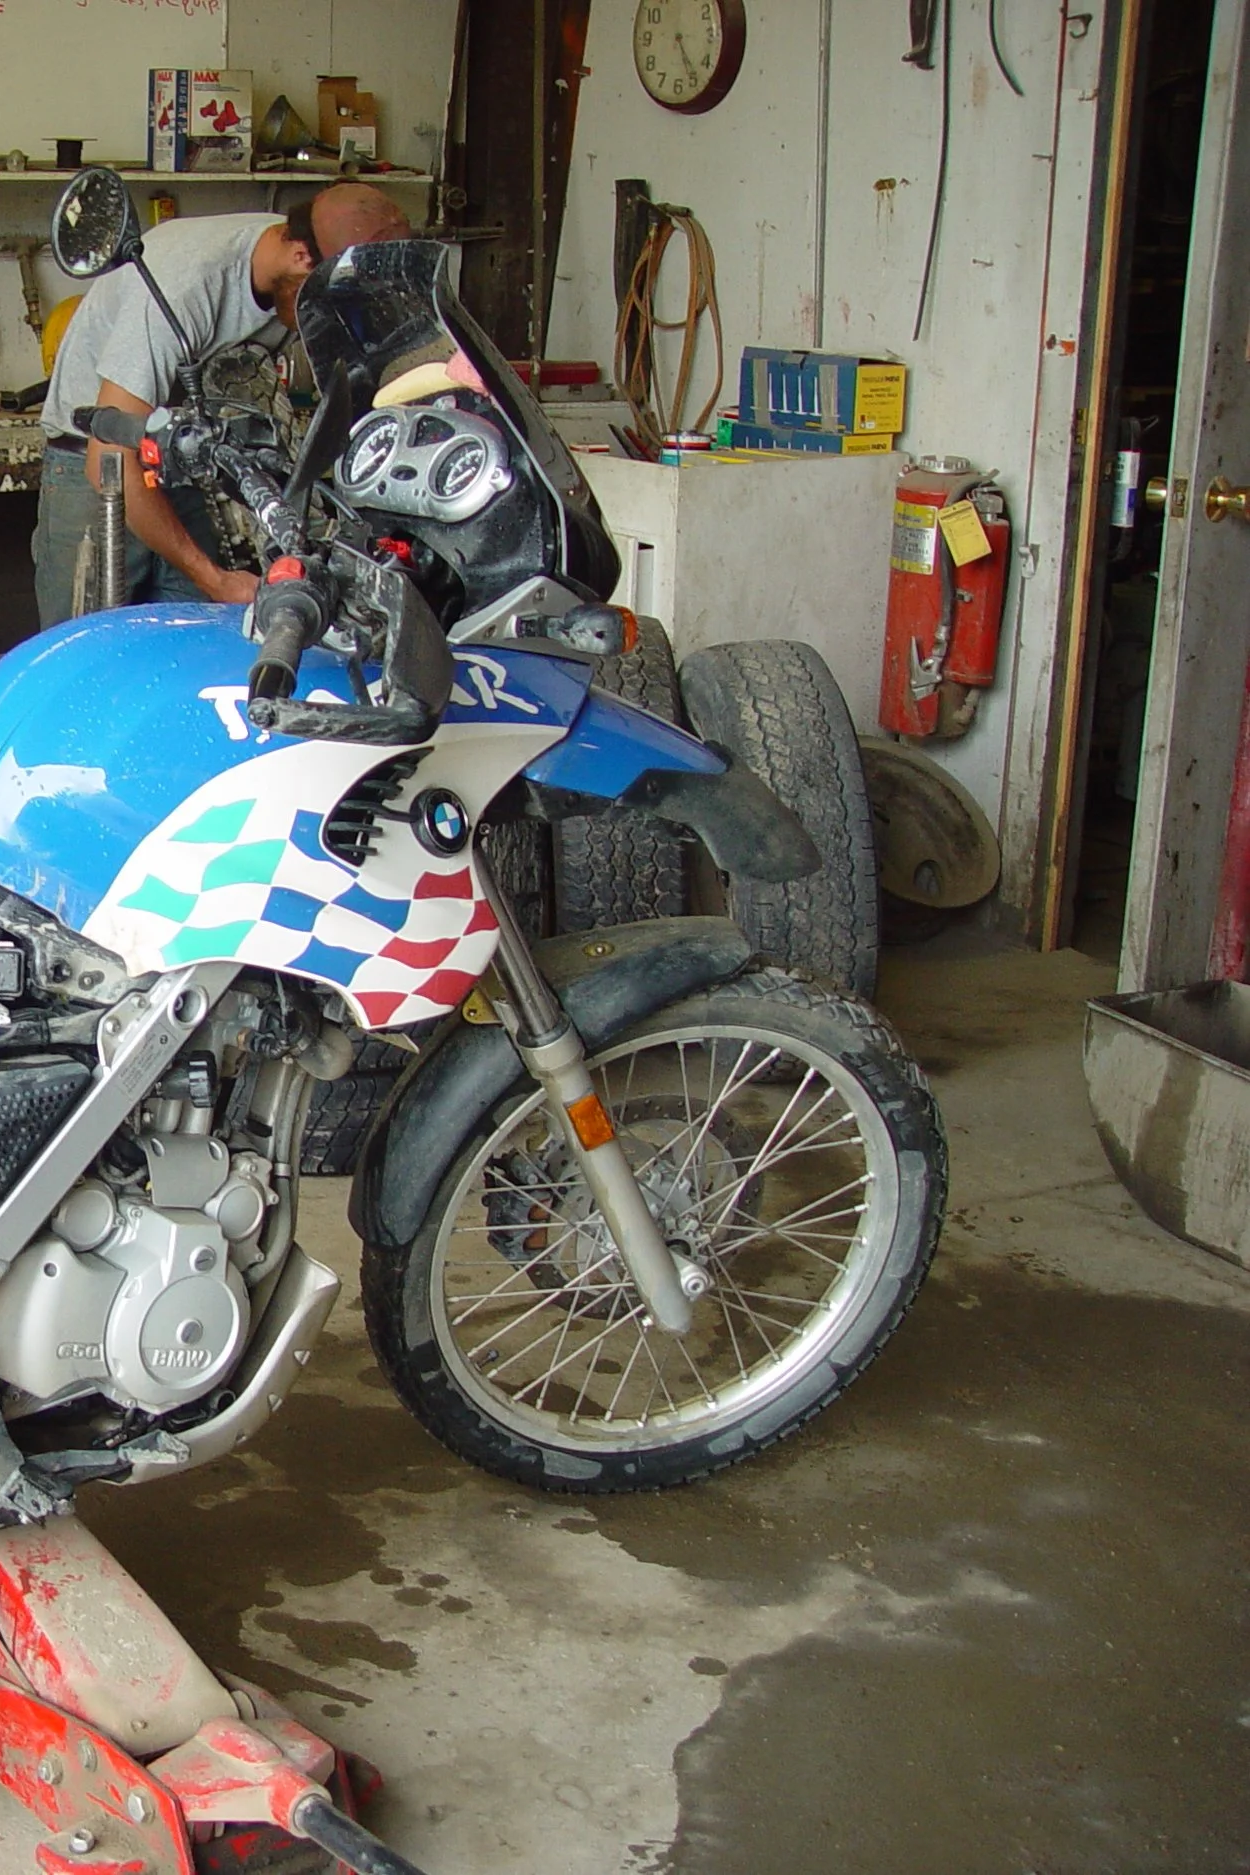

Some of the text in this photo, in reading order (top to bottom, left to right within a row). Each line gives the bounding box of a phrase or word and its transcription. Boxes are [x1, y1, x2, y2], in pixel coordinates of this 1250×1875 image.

[648, 7, 661, 24] 10
[701, 3, 711, 20] 2
[642, 31, 652, 47] 9
[646, 55, 655, 71] 8
[701, 54, 711, 69] 4
[192, 71, 219, 82] MAX
[657, 72, 666, 88] 7
[689, 71, 698, 88] 5
[673, 78, 683, 95] 6
[57, 1342, 101, 1360] 650
[152, 1350, 212, 1369] BMW
